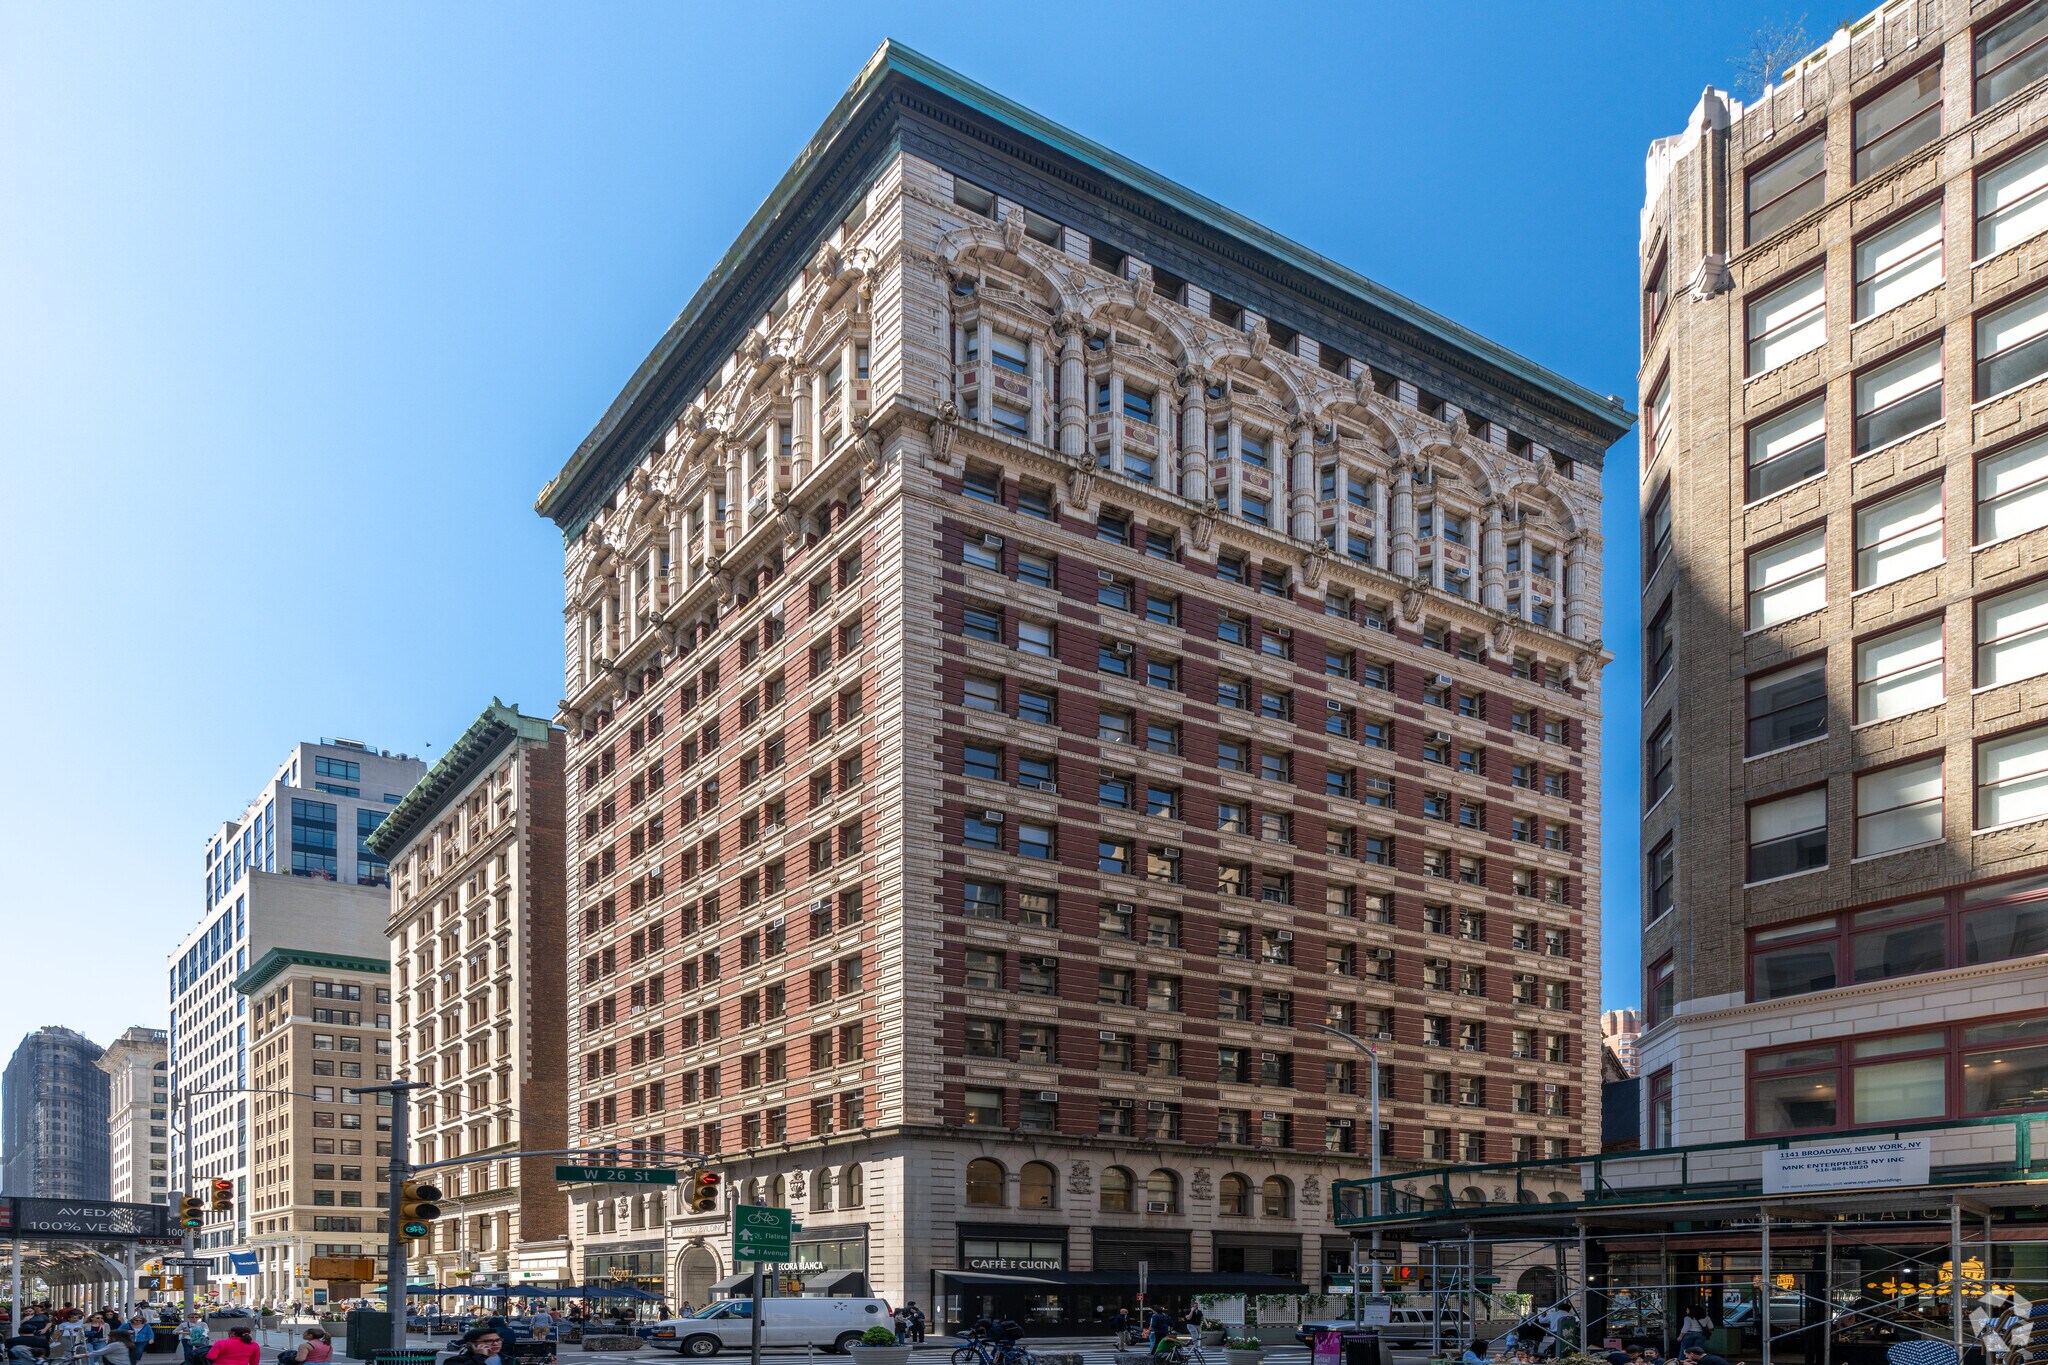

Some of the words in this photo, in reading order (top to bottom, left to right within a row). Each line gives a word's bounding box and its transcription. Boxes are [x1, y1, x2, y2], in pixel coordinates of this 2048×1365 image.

[1780, 1151, 1799, 1159] 1141
[1801, 1147, 1852, 1157] BROADWAY,
[1854, 1145, 1877, 1153] NEW
[1878, 1143, 1907, 1151] YORK,
[1908, 1141, 1921, 1149] NY
[1806, 1160, 1868, 1169] ENTERPRISES
[584, 1169, 599, 1180] W
[607, 1170, 626, 1181] 26
[634, 1171, 650, 1182] St
[57, 1207, 119, 1218] AVEDA
[30, 1221, 81, 1232] 100%
[765, 1232, 788, 1240] Flatiron
[763, 1249, 788, 1257] Avenue
[764, 1263, 773, 1271] LA
[777, 1262, 798, 1271] ECORA
[798, 1261, 824, 1270] BIANCA
[971, 1258, 1007, 1269] CAFFÈ
[1010, 1260, 1016, 1269] E
[1019, 1260, 1060, 1270] CUCINA
[1337, 1264, 1393, 1274] INDY
